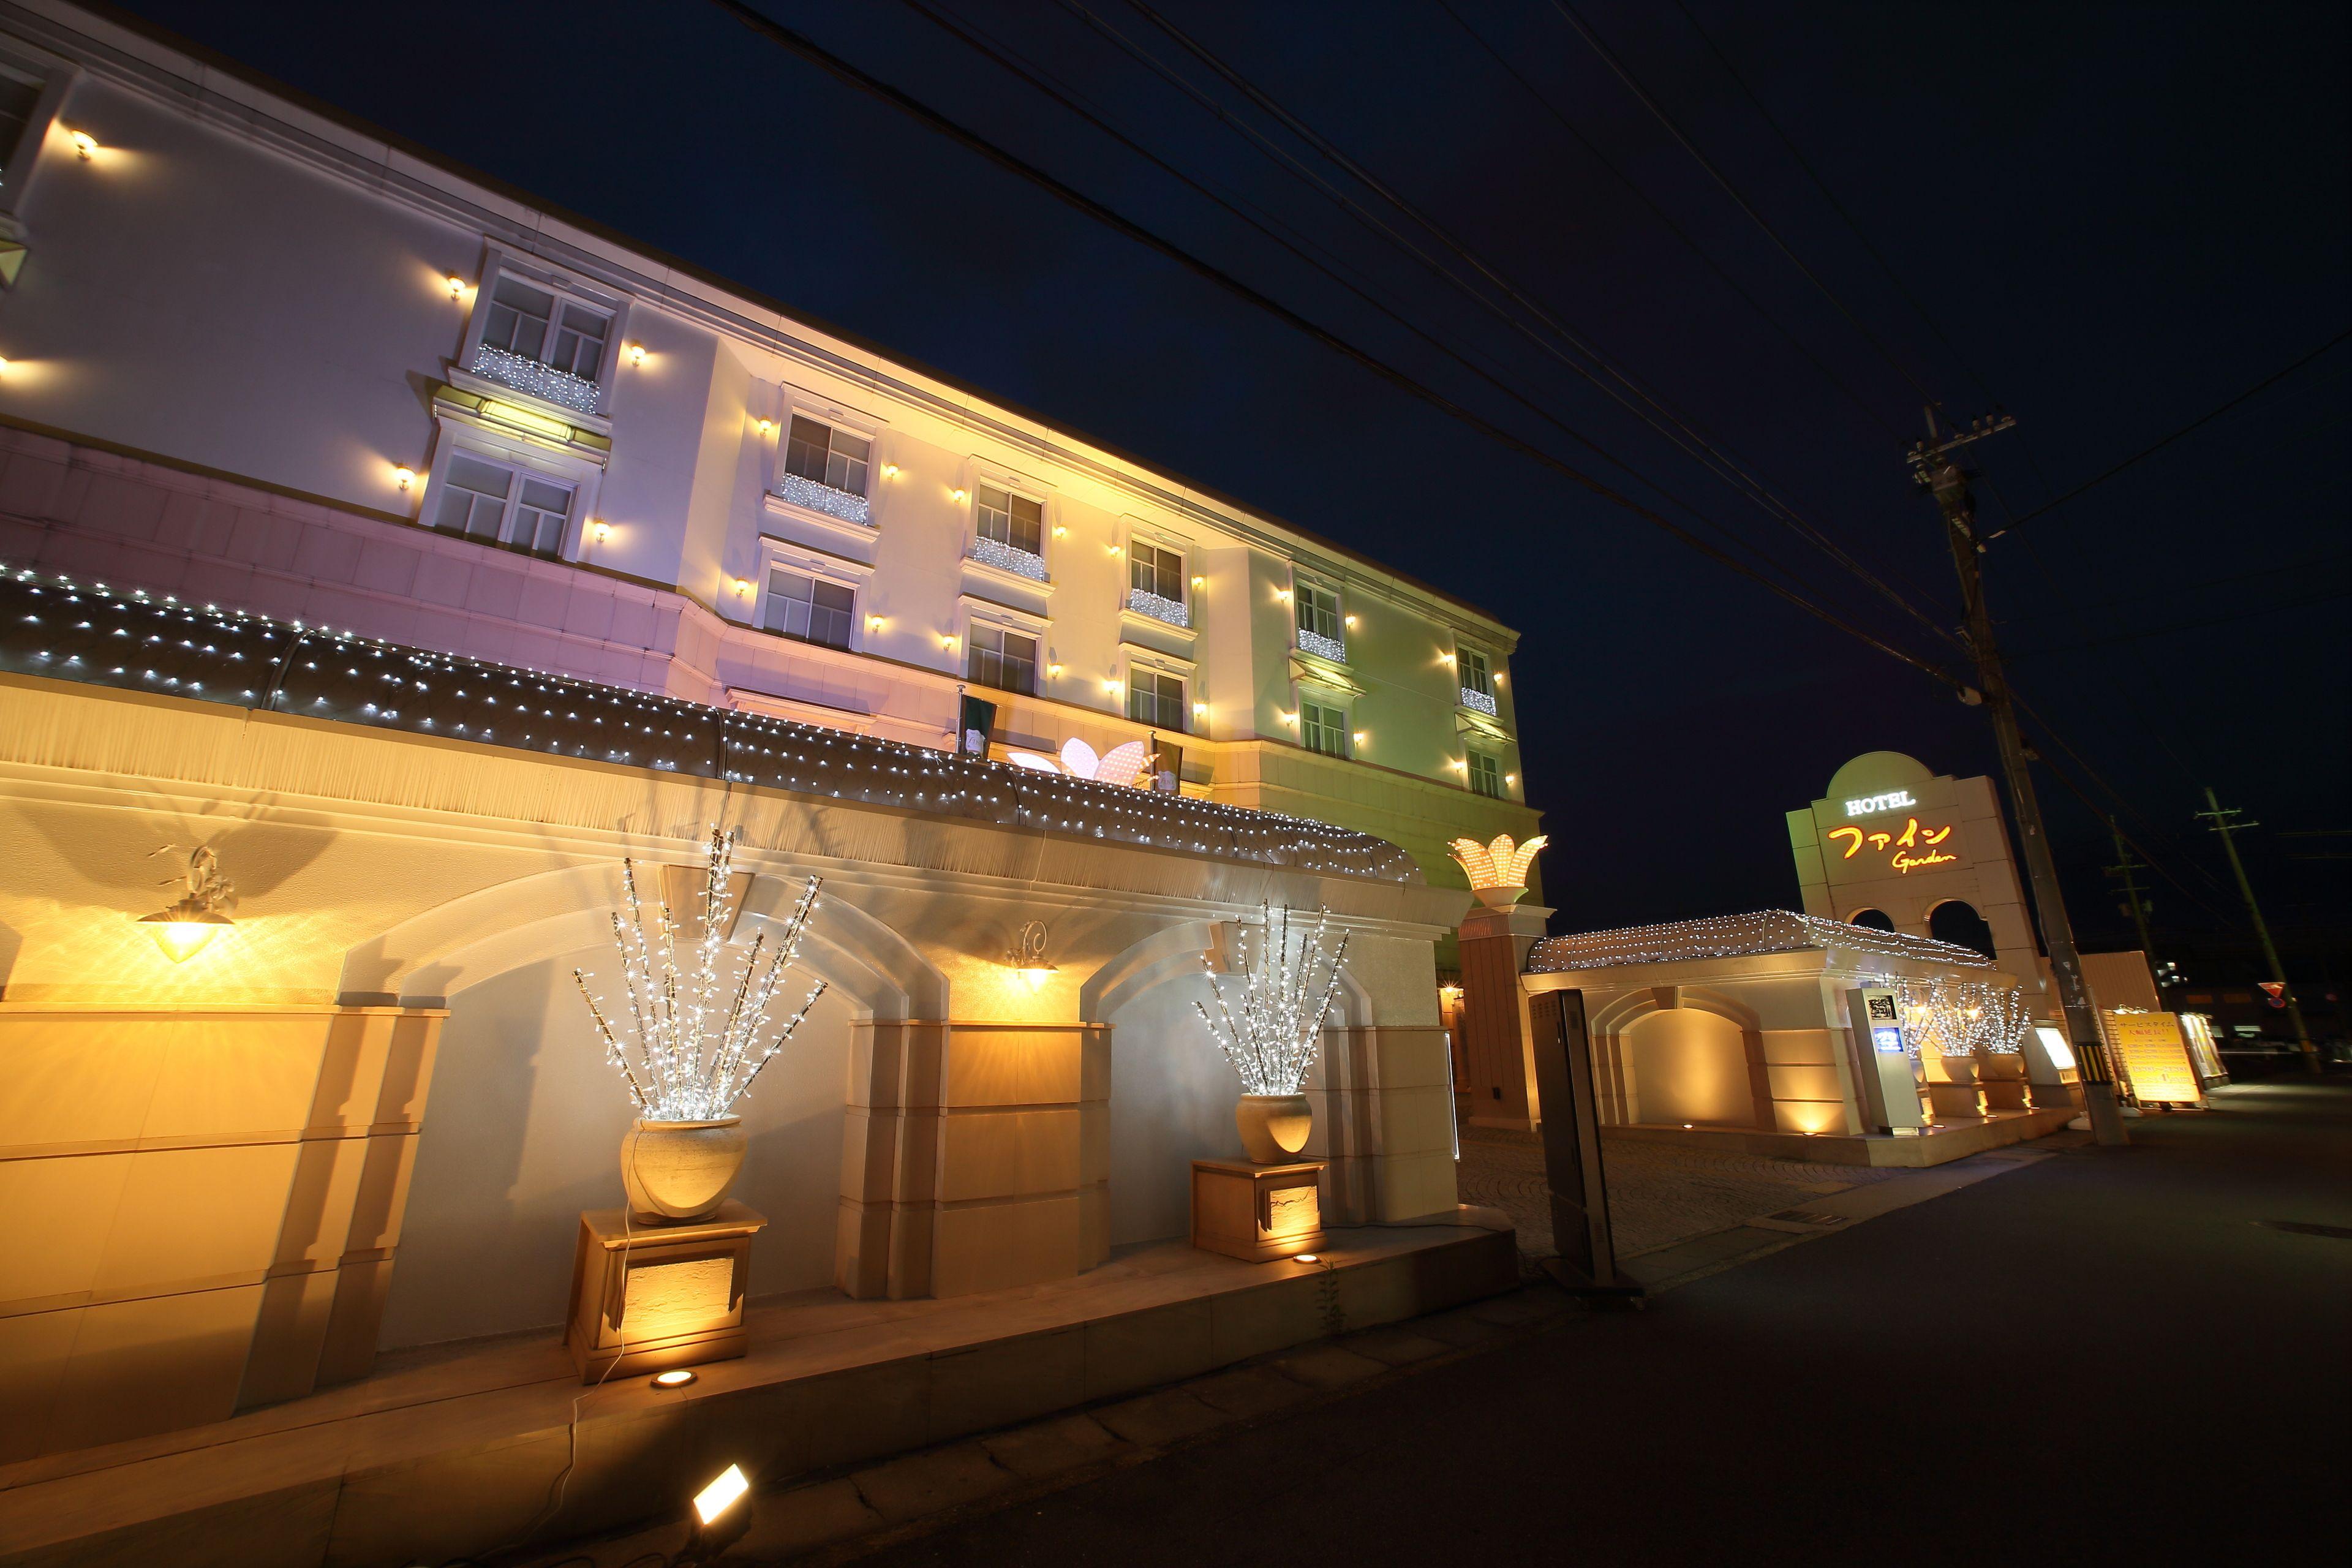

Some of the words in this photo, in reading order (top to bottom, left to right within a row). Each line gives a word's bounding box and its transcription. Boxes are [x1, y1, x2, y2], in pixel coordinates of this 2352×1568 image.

[1845, 791, 1916, 816] HOTEL
[1828, 818, 1951, 859] ファイン
[1891, 849, 1958, 874] Garden
